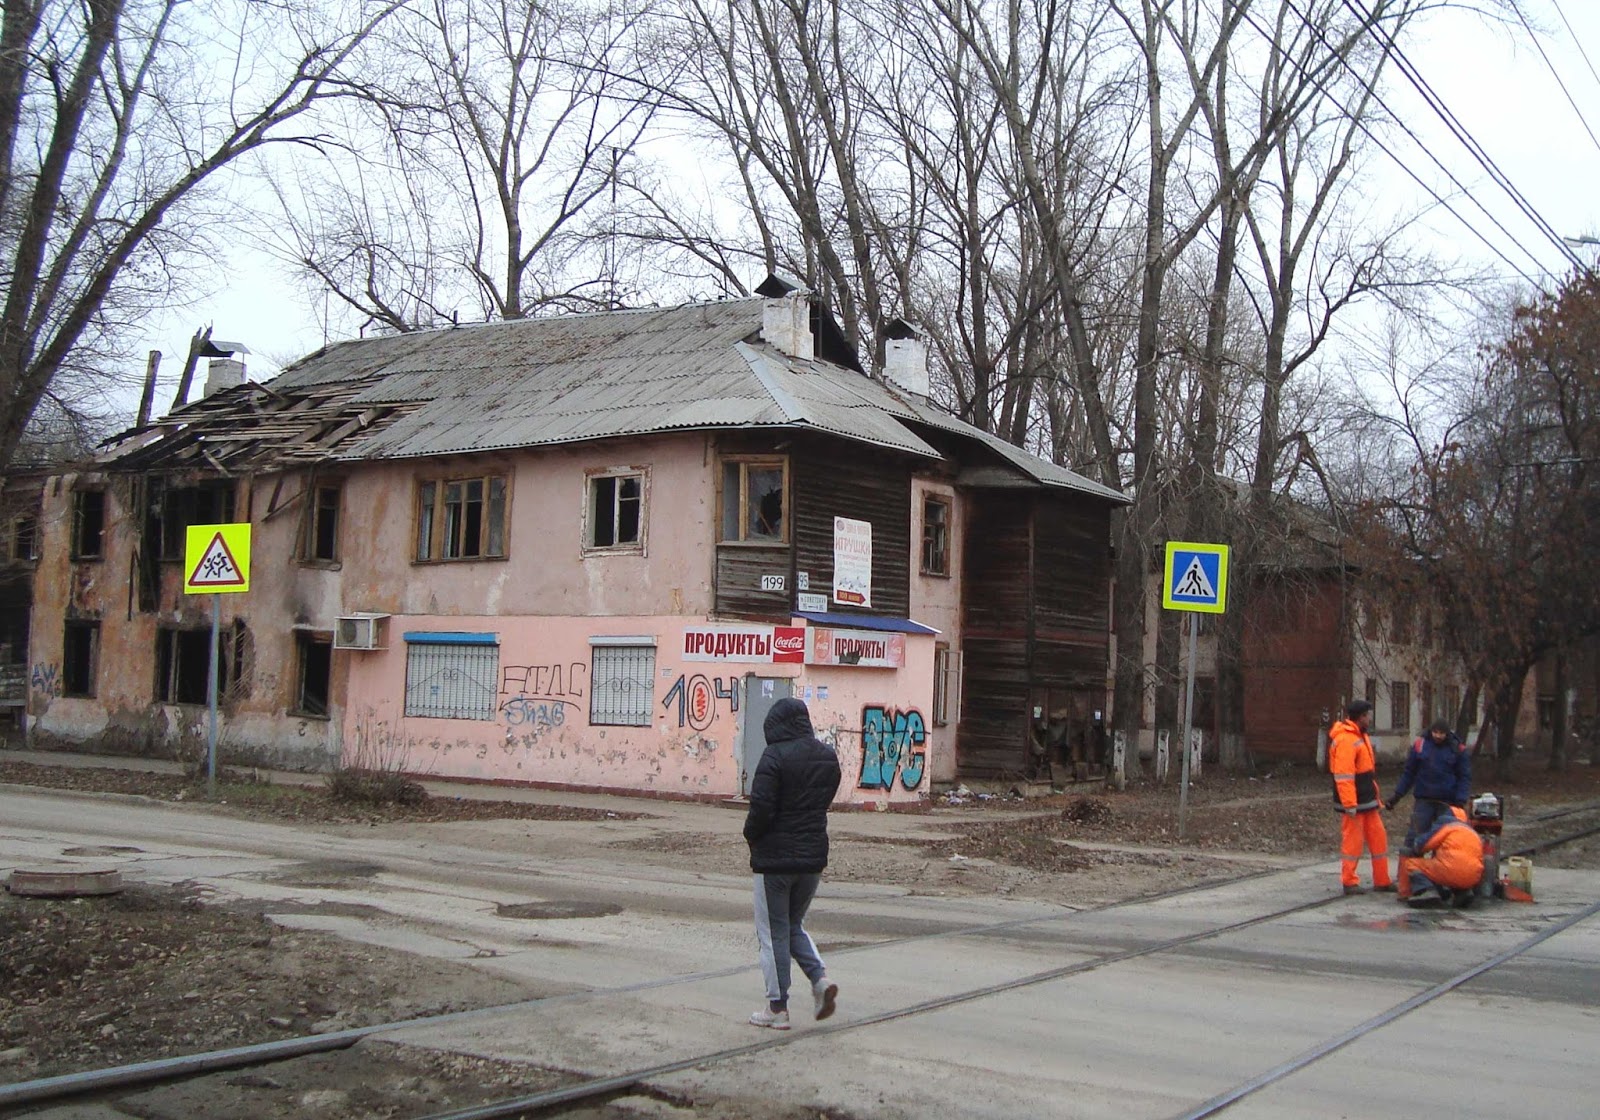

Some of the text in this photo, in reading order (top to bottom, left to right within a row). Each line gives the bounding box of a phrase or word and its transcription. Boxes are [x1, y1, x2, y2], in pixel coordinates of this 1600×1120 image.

[763, 576, 784, 589] 199
[799, 574, 808, 587] 95
[685, 632, 771, 658] ПРОДУКТЫ
[834, 637, 886, 660] ПРОДУКТЫ
